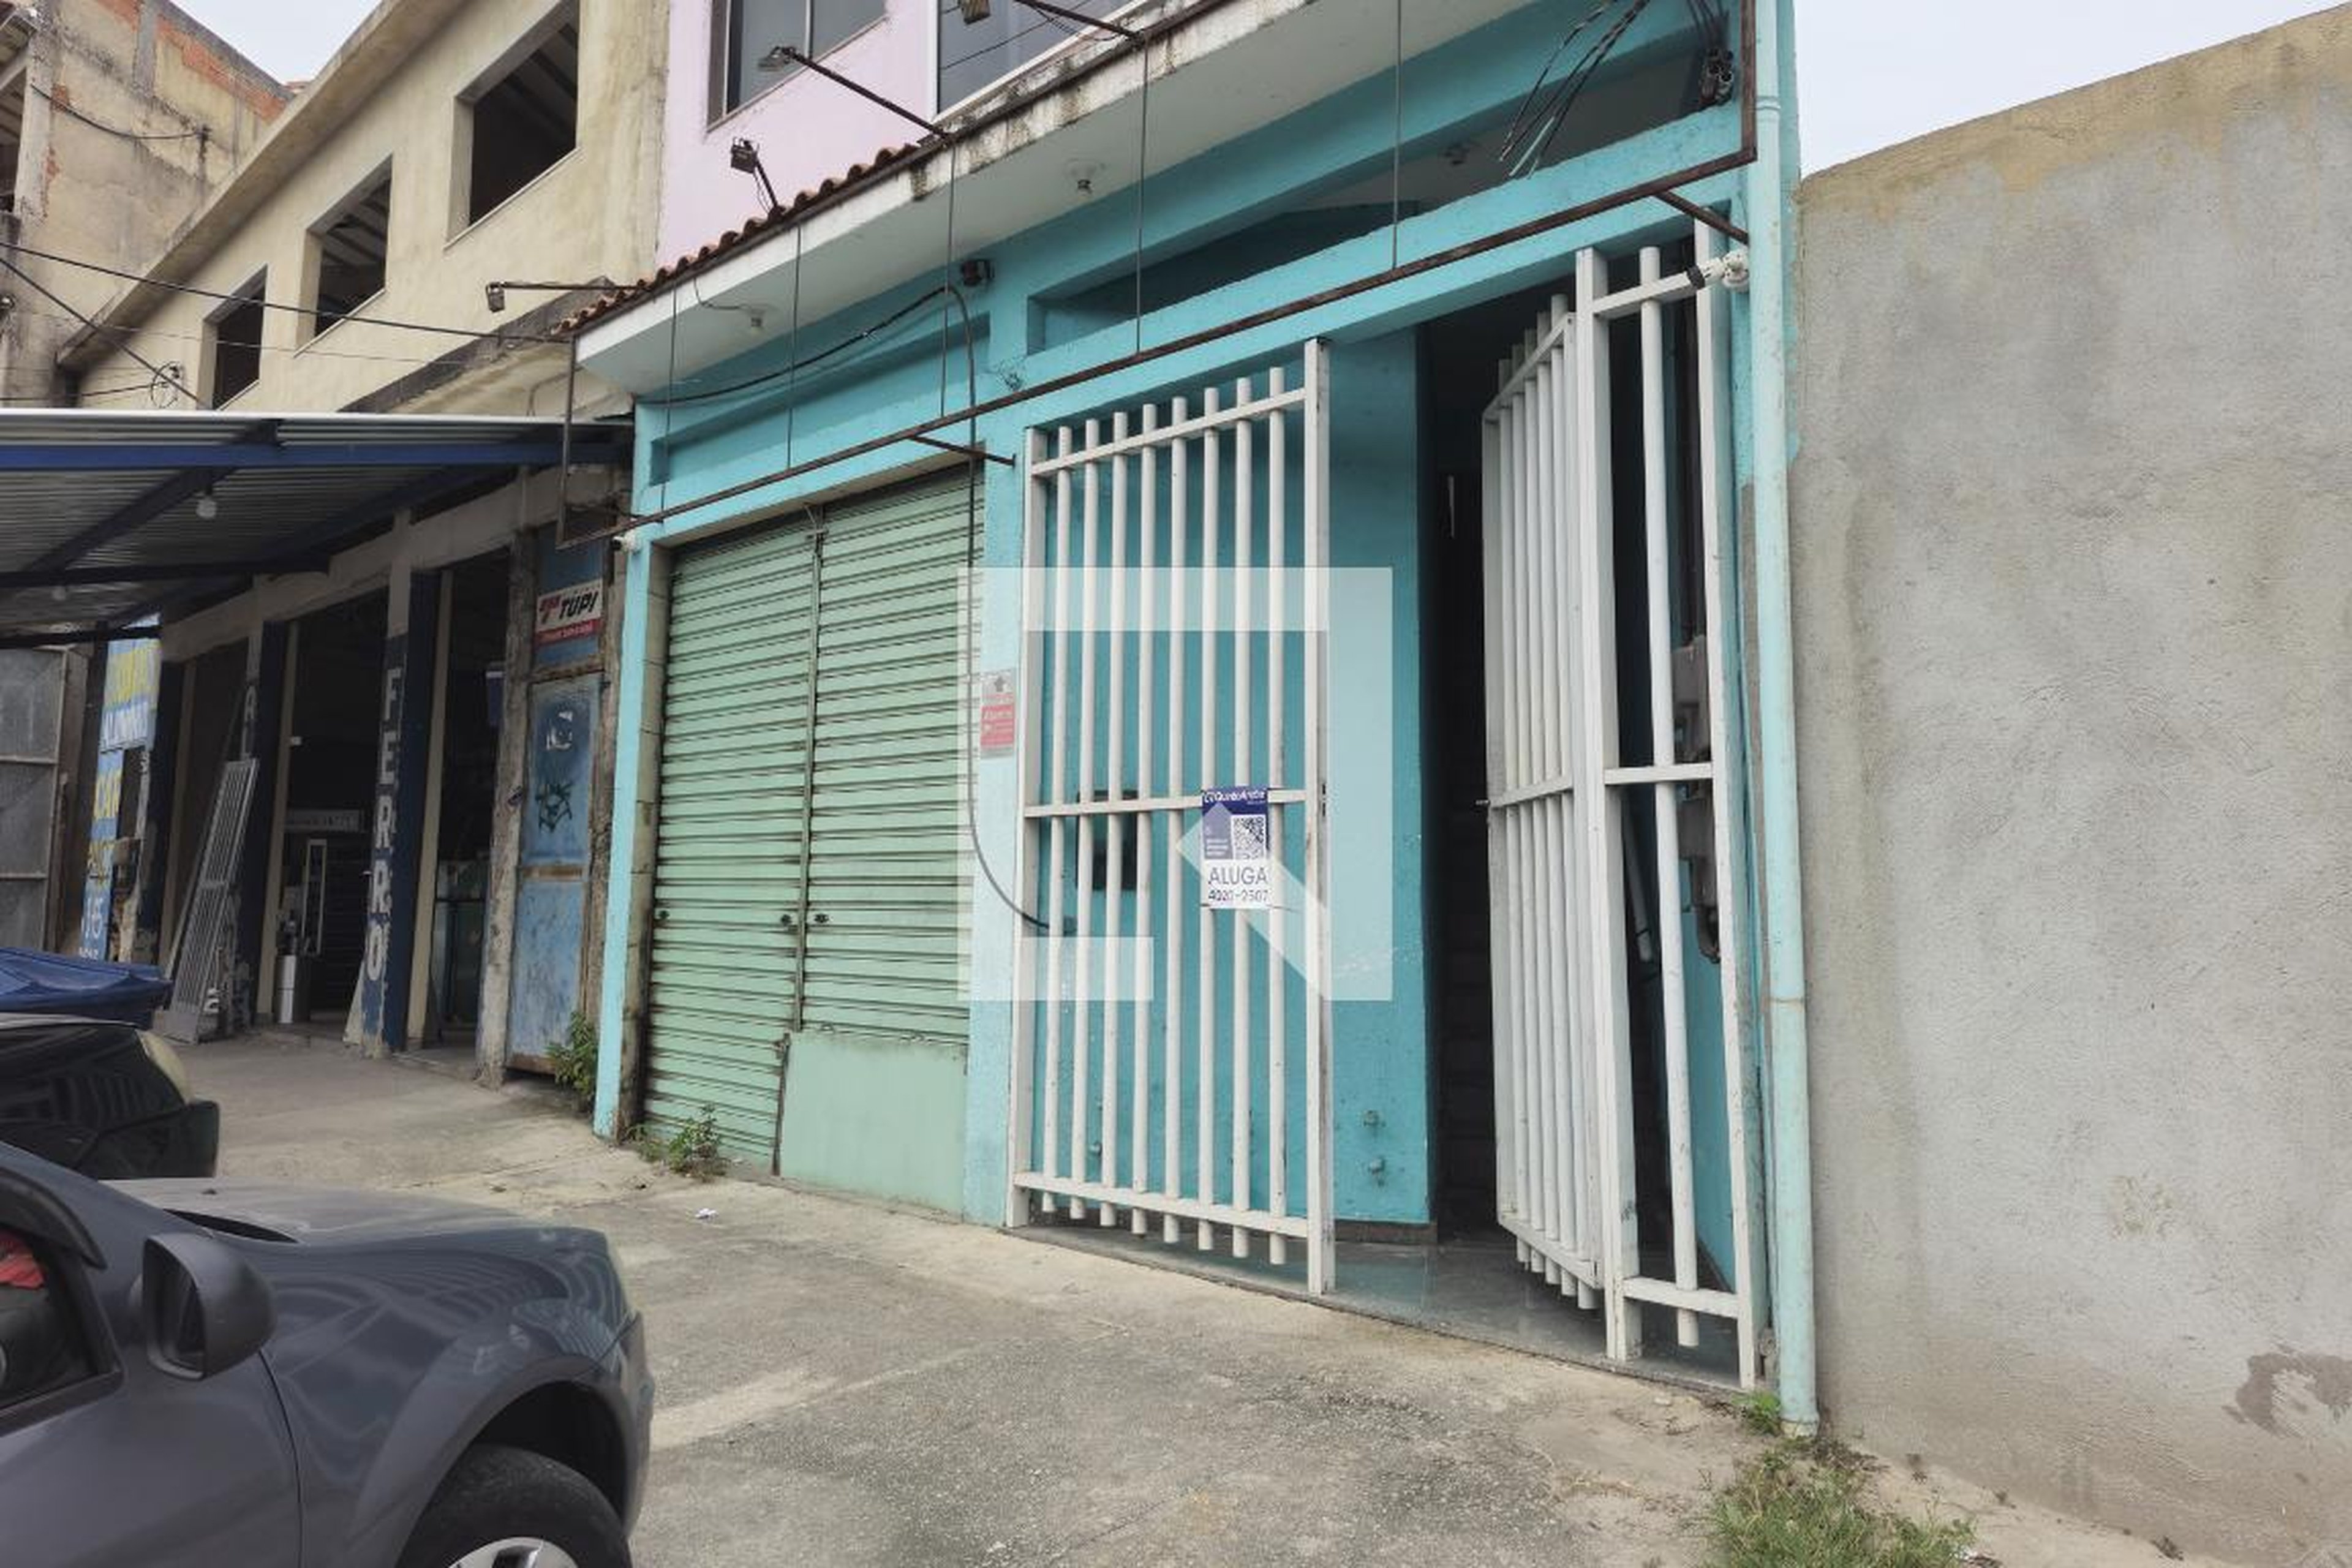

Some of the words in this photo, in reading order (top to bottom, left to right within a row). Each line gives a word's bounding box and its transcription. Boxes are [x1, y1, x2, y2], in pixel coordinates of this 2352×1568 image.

[559, 591, 598, 619] TUPI
[367, 668, 402, 981] FERRO
[1208, 865, 1268, 885] ALUGA
